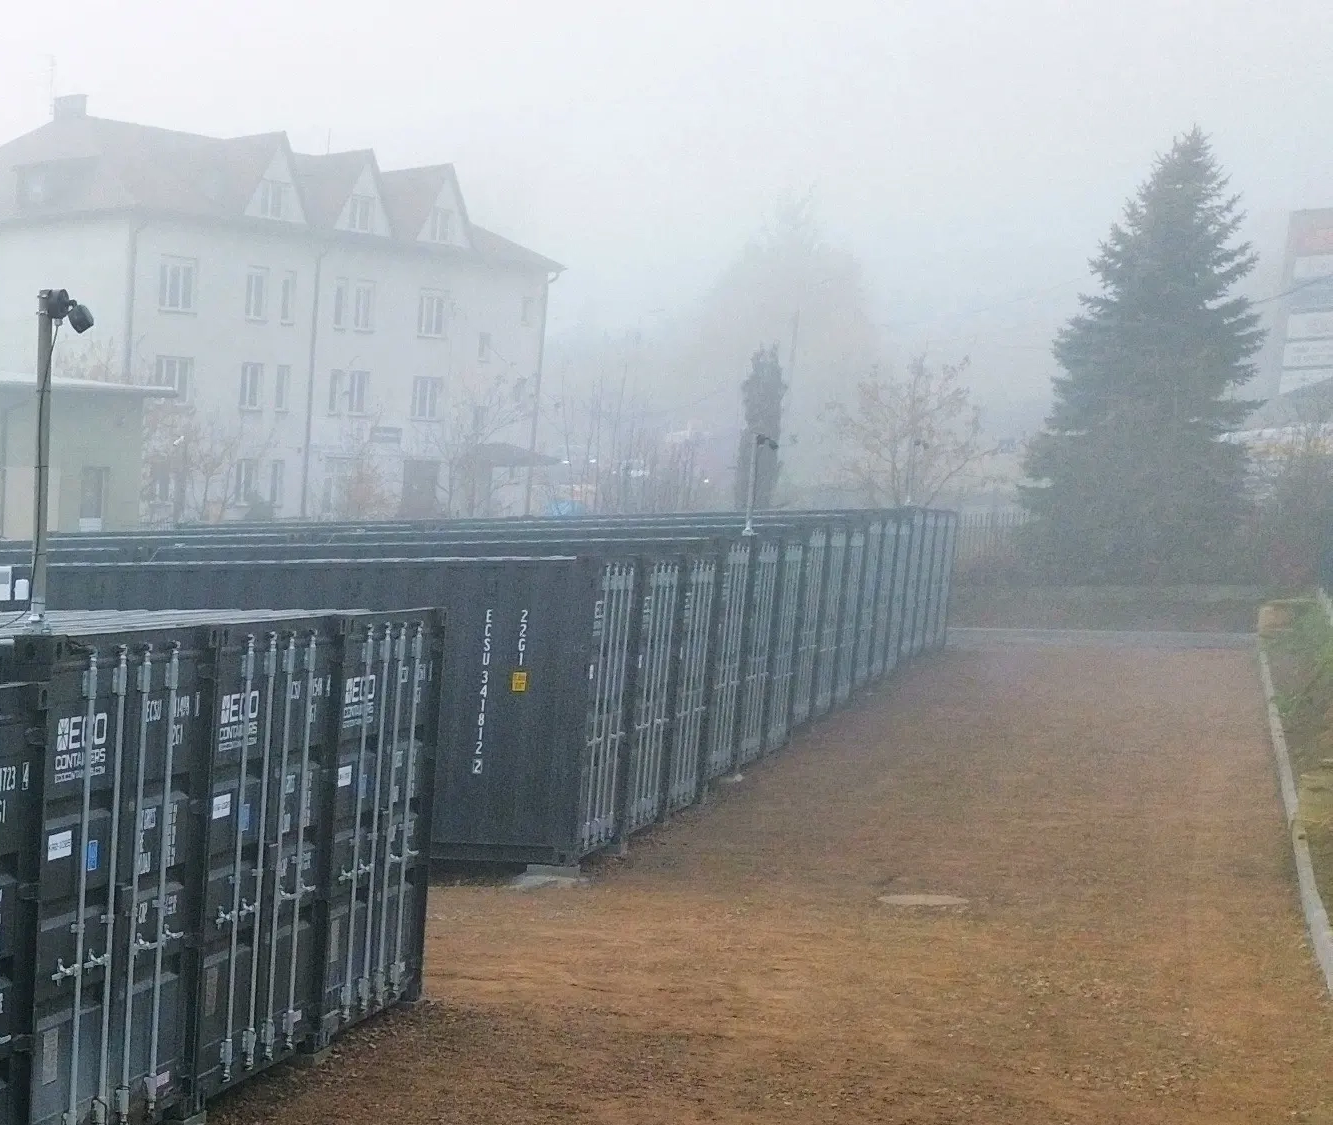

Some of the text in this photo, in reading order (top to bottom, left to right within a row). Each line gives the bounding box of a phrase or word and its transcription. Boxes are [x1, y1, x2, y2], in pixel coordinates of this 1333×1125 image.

[483, 609, 493, 665] ECSU
[518, 610, 528, 666] 22G1
[475, 671, 489, 755] 341812
